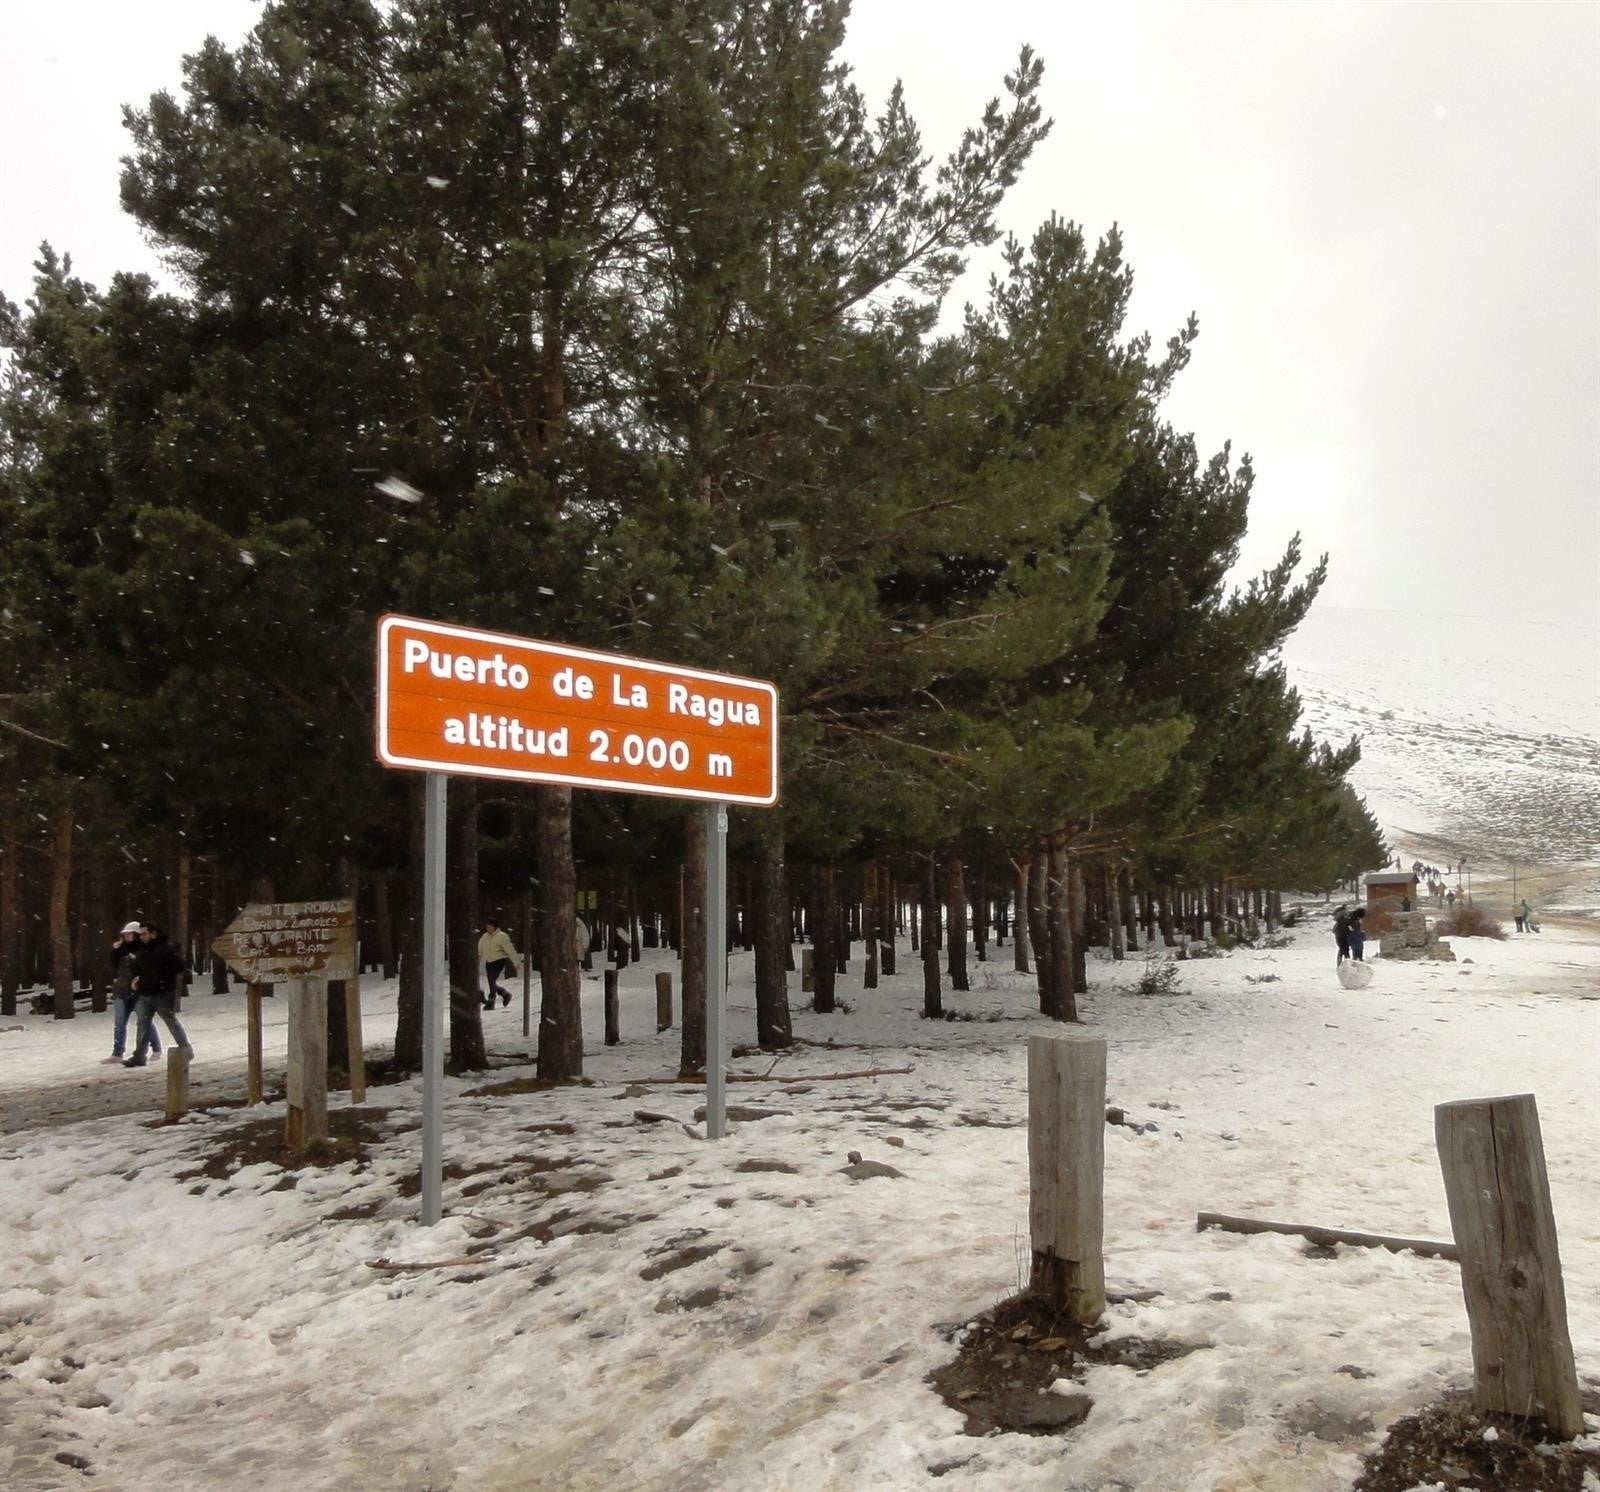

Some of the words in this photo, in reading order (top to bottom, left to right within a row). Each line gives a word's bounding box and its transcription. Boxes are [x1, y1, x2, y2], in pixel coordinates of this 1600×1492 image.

[404, 638, 530, 690] Puerto
[552, 666, 594, 700] de
[612, 673, 649, 709] La
[668, 682, 761, 727] Ragua
[443, 712, 569, 757] altitud
[588, 729, 690, 772] 2.000
[708, 753, 733, 778] m
[255, 903, 298, 916] HOTEL
[303, 901, 345, 914] RURAL
[233, 928, 330, 945] RETURANTE
